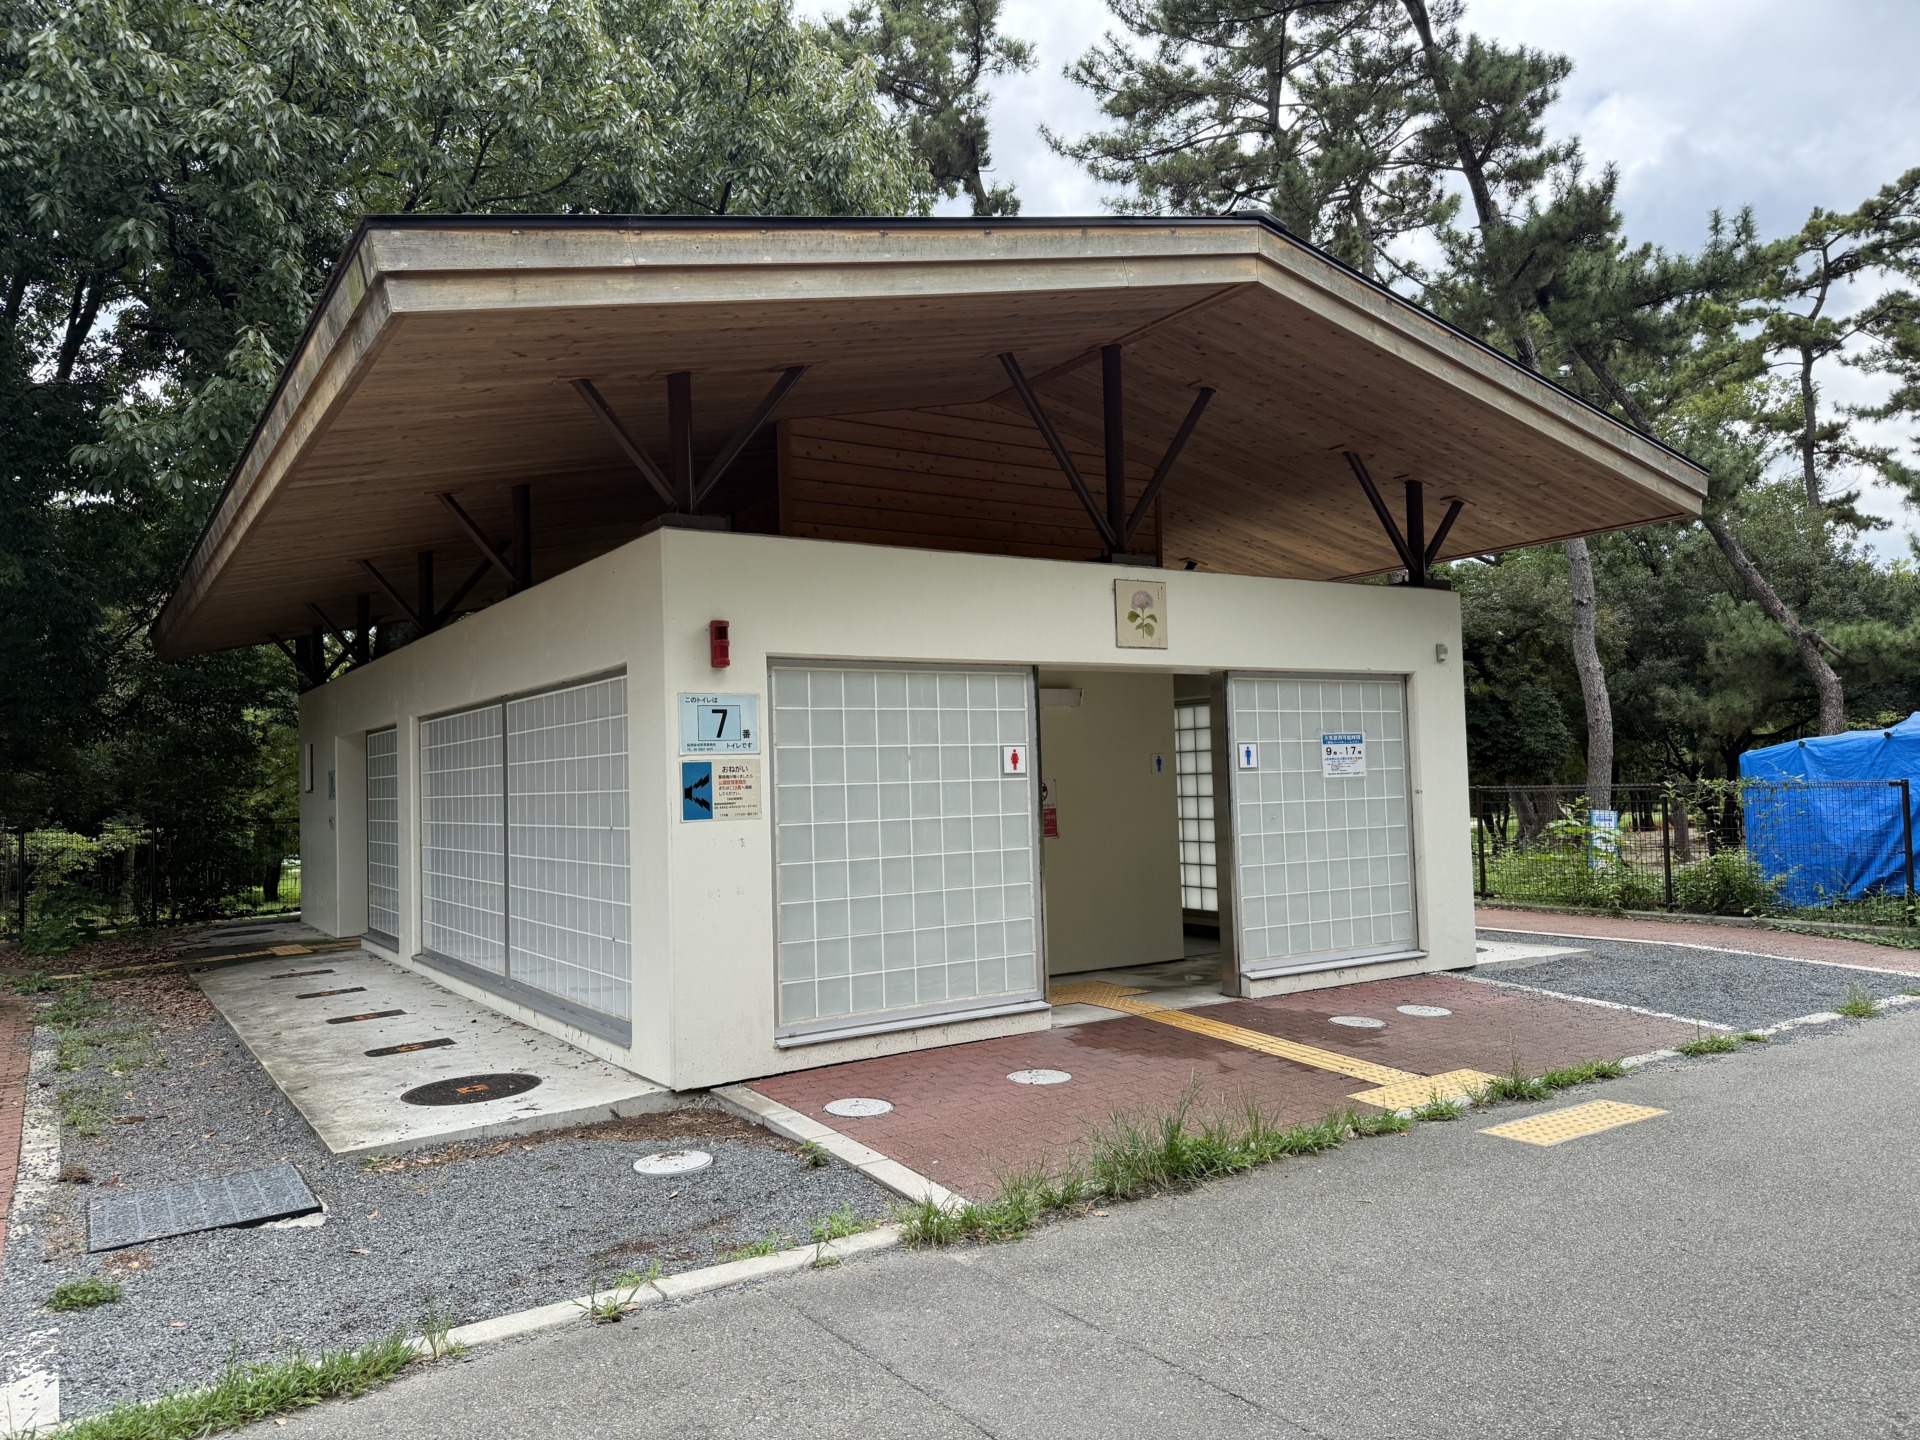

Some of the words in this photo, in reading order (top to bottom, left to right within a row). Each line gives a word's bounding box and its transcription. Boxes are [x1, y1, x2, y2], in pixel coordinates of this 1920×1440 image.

[711, 708, 728, 739] 7
[742, 729, 751, 739] 番
[721, 765, 749, 773] おねがい
